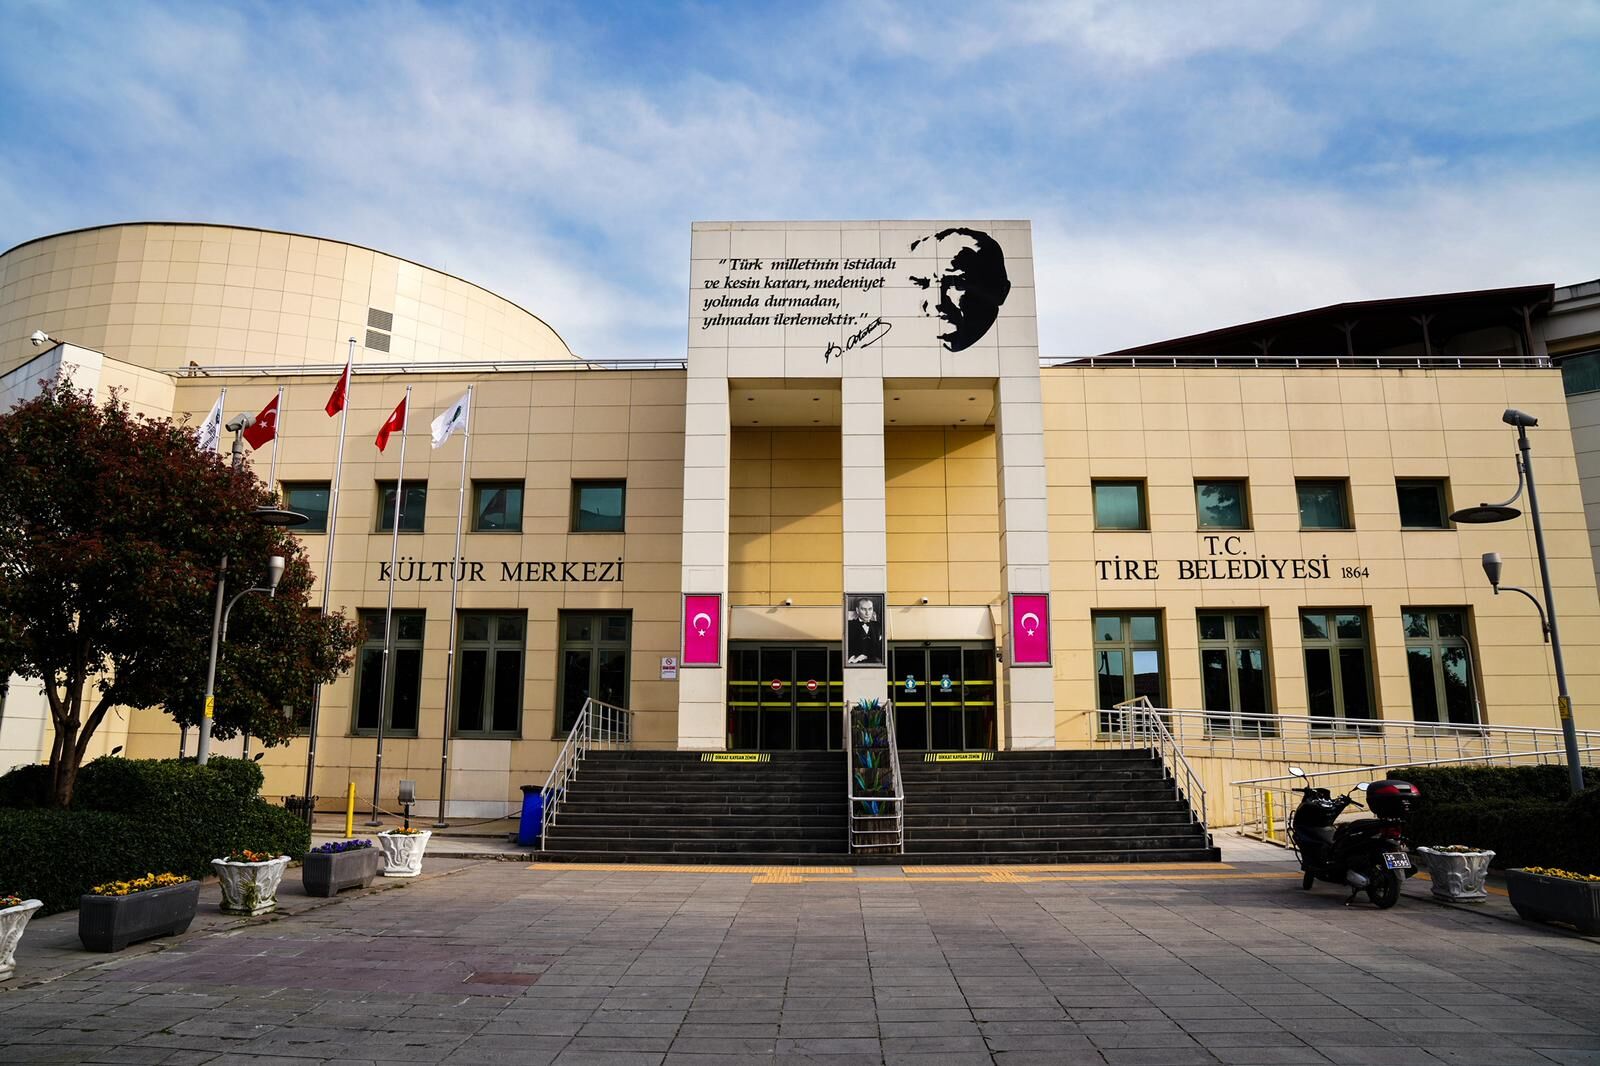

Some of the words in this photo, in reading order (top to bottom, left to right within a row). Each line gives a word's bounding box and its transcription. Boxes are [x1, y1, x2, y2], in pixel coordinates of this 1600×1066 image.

[771, 258, 838, 270] milletinin
[843, 257, 896, 270] istidadı
[703, 279, 720, 289] ve
[723, 276, 760, 289] kesin
[764, 276, 810, 290] kararı,
[814, 275, 886, 292] medeniyet
[703, 295, 759, 311] yolunda
[764, 294, 840, 309] durmadan,
[702, 313, 769, 329] yılmadan
[1203, 535, 1247, 556] T.C.
[378, 557, 486, 582] KÜLTÜR
[499, 557, 624, 582] MERKEZİ
[1095, 555, 1160, 581] TİRE
[1177, 554, 1331, 580] BELEDİYESİ
[1341, 567, 1370, 579] 1864
